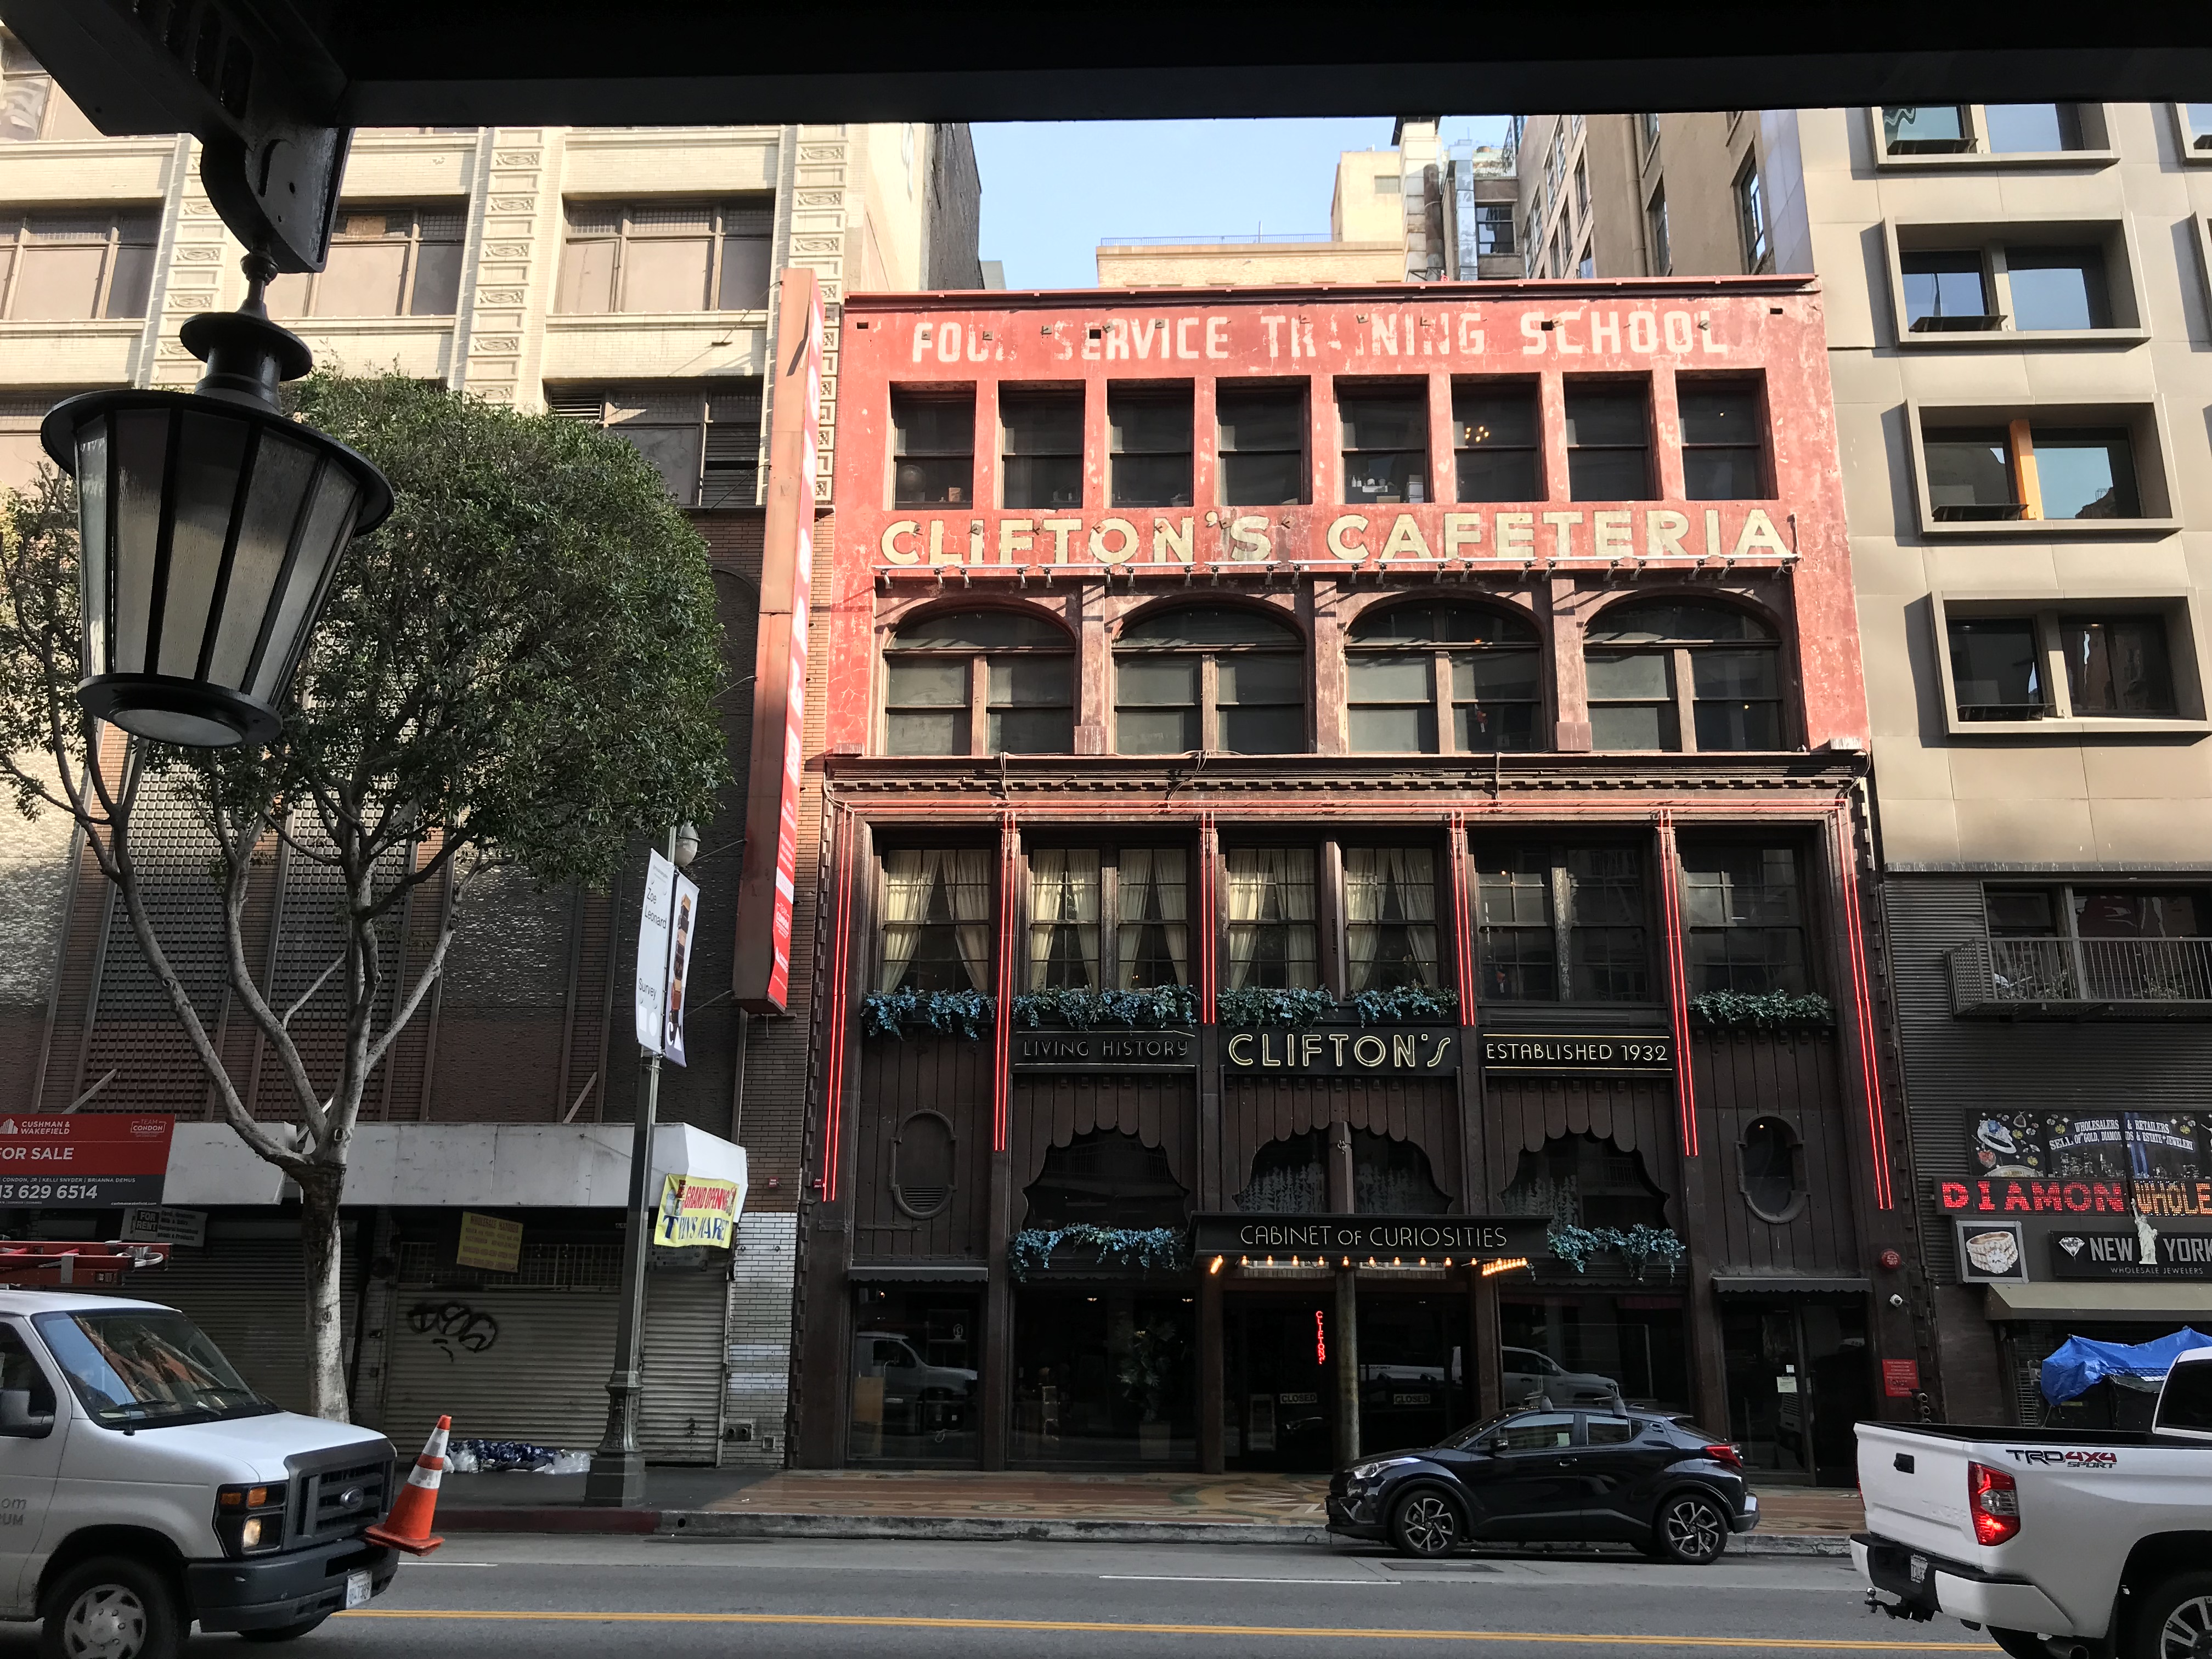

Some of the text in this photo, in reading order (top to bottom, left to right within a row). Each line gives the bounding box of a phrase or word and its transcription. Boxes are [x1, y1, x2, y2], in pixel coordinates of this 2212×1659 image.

[1053, 317, 1228, 360] SERVICE
[1521, 311, 1728, 356] SCHOOL
[879, 509, 1793, 565] CLIFTON'S CAFETERIA
[646, 887, 657, 905] Zoe
[644, 909, 667, 930] Leonard
[638, 978, 657, 1001] Survey
[1023, 1040, 1189, 1058] LIVING HISTORY
[1228, 1032, 1451, 1068] CLIFTON'S
[1486, 1043, 1668, 1061] ESTABLISHED 1932
[2074, 1119, 2170, 1134] WHOLESALERS & RETAILERS
[2049, 1136, 2074, 1151] SELL
[2136, 1131, 2141, 1141] &
[2142, 1132, 2163, 1144] ESTATE
[31, 1147, 75, 1160] SALE
[18, 1185, 52, 1199] 629
[57, 1185, 98, 1199] 6514
[684, 1185, 708, 1209] GRAND
[1941, 1181, 2125, 1212] DIAMON
[136, 1220, 157, 1231] RENT
[140, 1211, 156, 1222] FOR
[1240, 1225, 1508, 1248] CABINET OF CURIOSITIES
[2089, 1238, 2133, 1262] NEW
[1281, 1394, 1316, 1403] CLOSED
[1395, 1395, 1430, 1403] CLOSED
[2005, 1449, 2066, 1466] TRD
